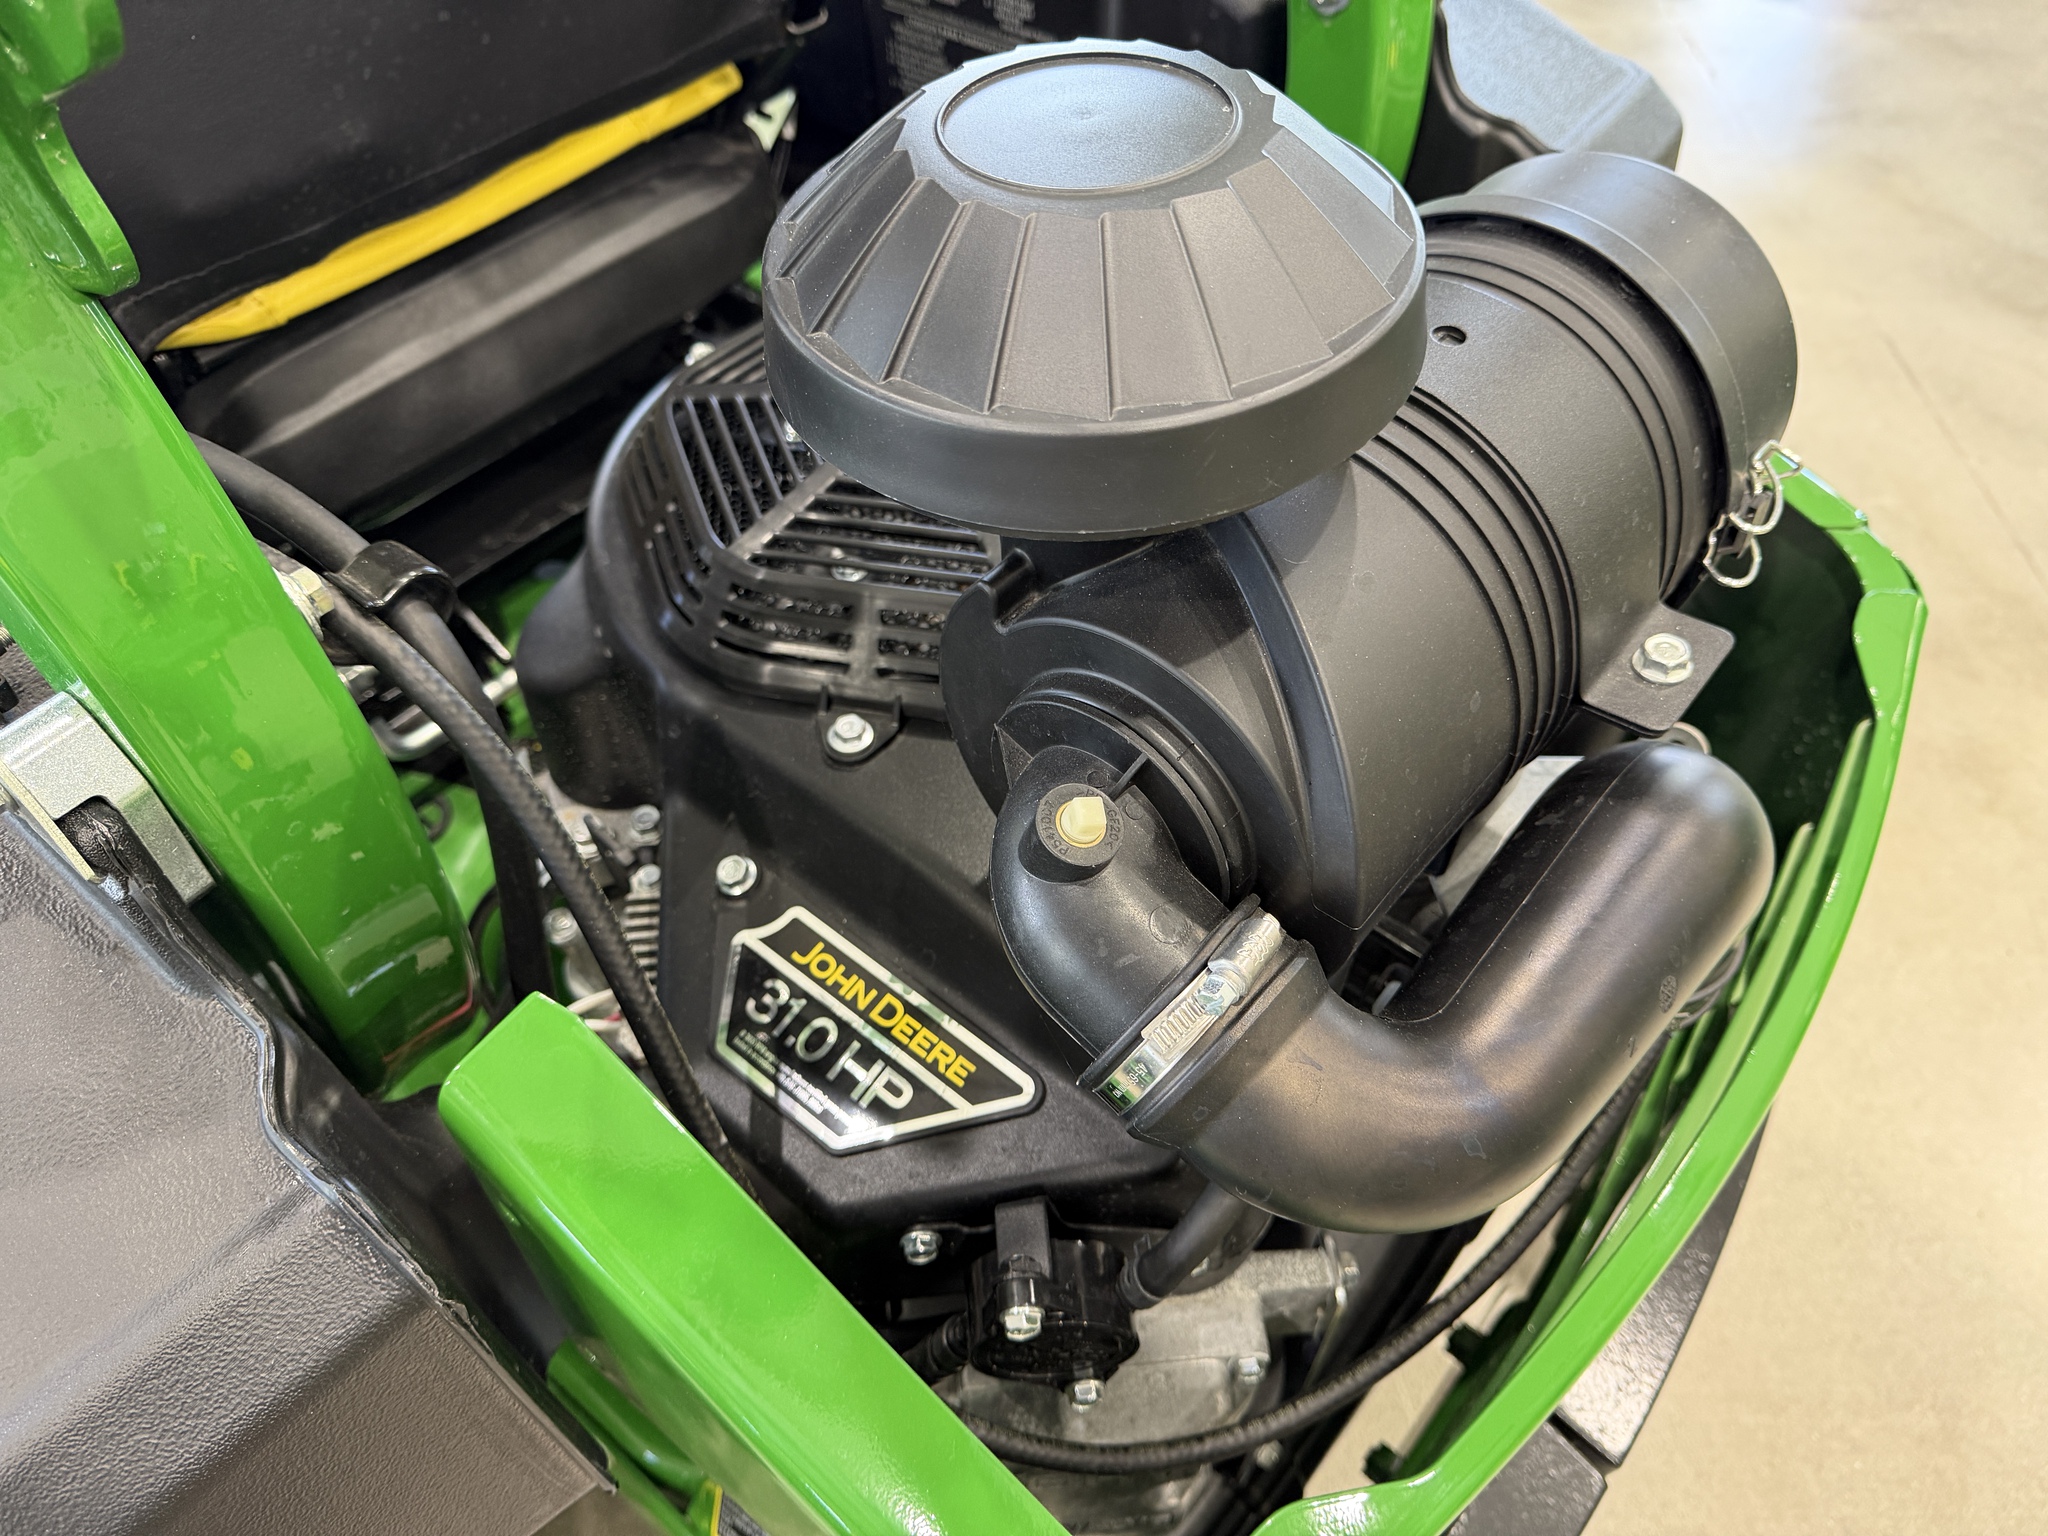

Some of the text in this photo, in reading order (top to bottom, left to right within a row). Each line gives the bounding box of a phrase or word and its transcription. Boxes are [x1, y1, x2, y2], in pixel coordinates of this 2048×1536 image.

[744, 977, 839, 1064] 31.0
[826, 1040, 914, 1110] HP
[790, 940, 878, 1012] JOHN
[868, 991, 977, 1088] DEERE
